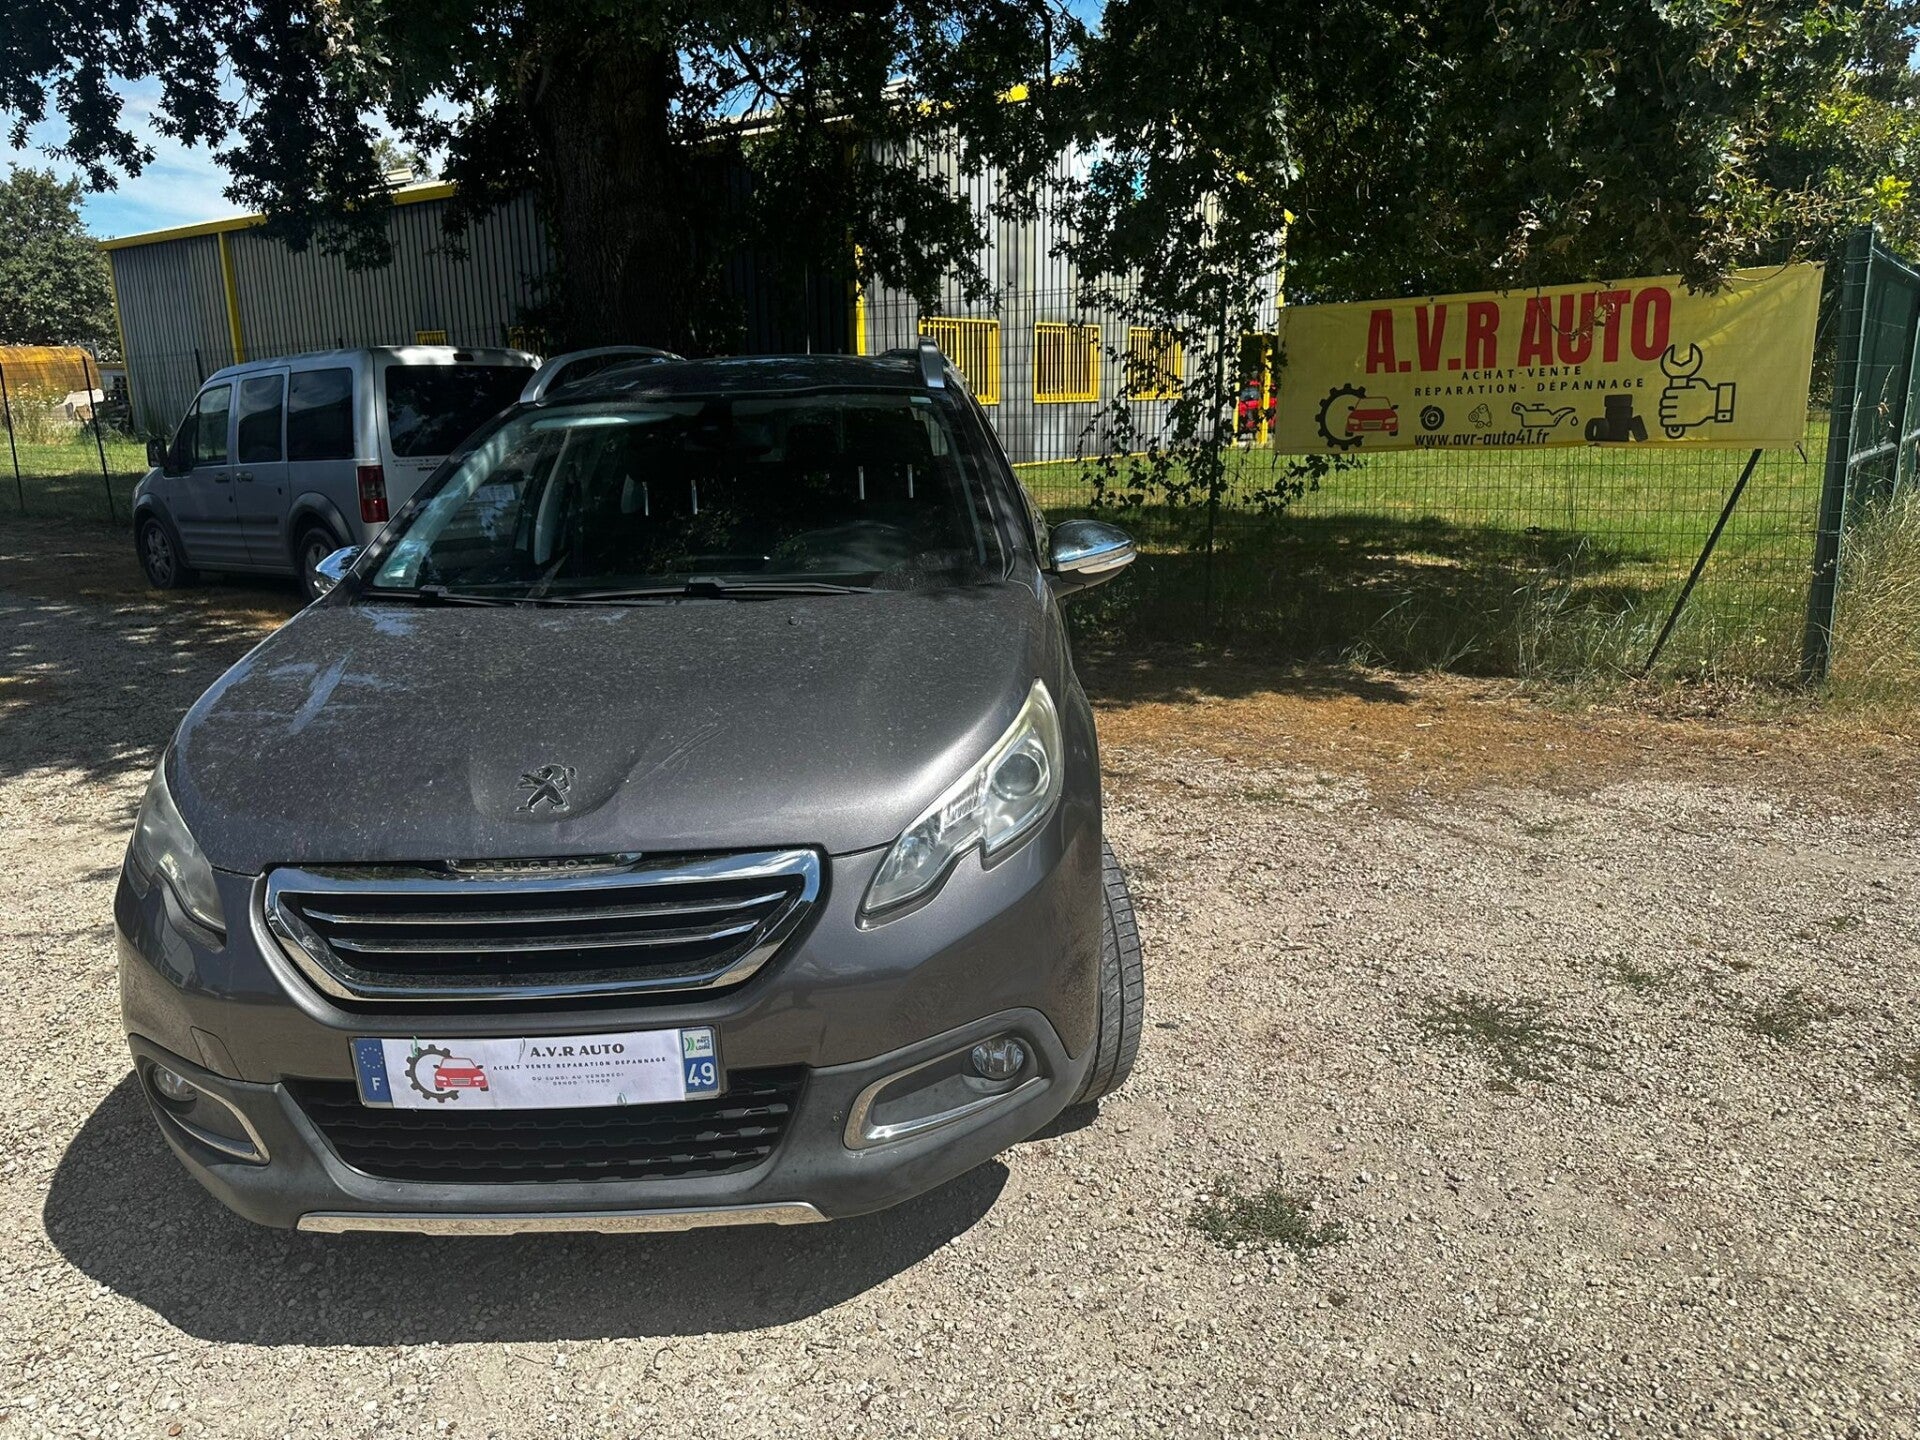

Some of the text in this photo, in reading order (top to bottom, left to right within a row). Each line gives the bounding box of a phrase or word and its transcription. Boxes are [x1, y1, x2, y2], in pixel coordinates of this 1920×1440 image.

[1366, 287, 1672, 374] A.V.R AUTO
[1414, 429, 1550, 446] www.avr-auto41.fr
[475, 858, 596, 873] PEUGEOT
[530, 1043, 625, 1058] A.V.R AUTO
[687, 1062, 716, 1087] 49
[371, 1077, 381, 1091] F
